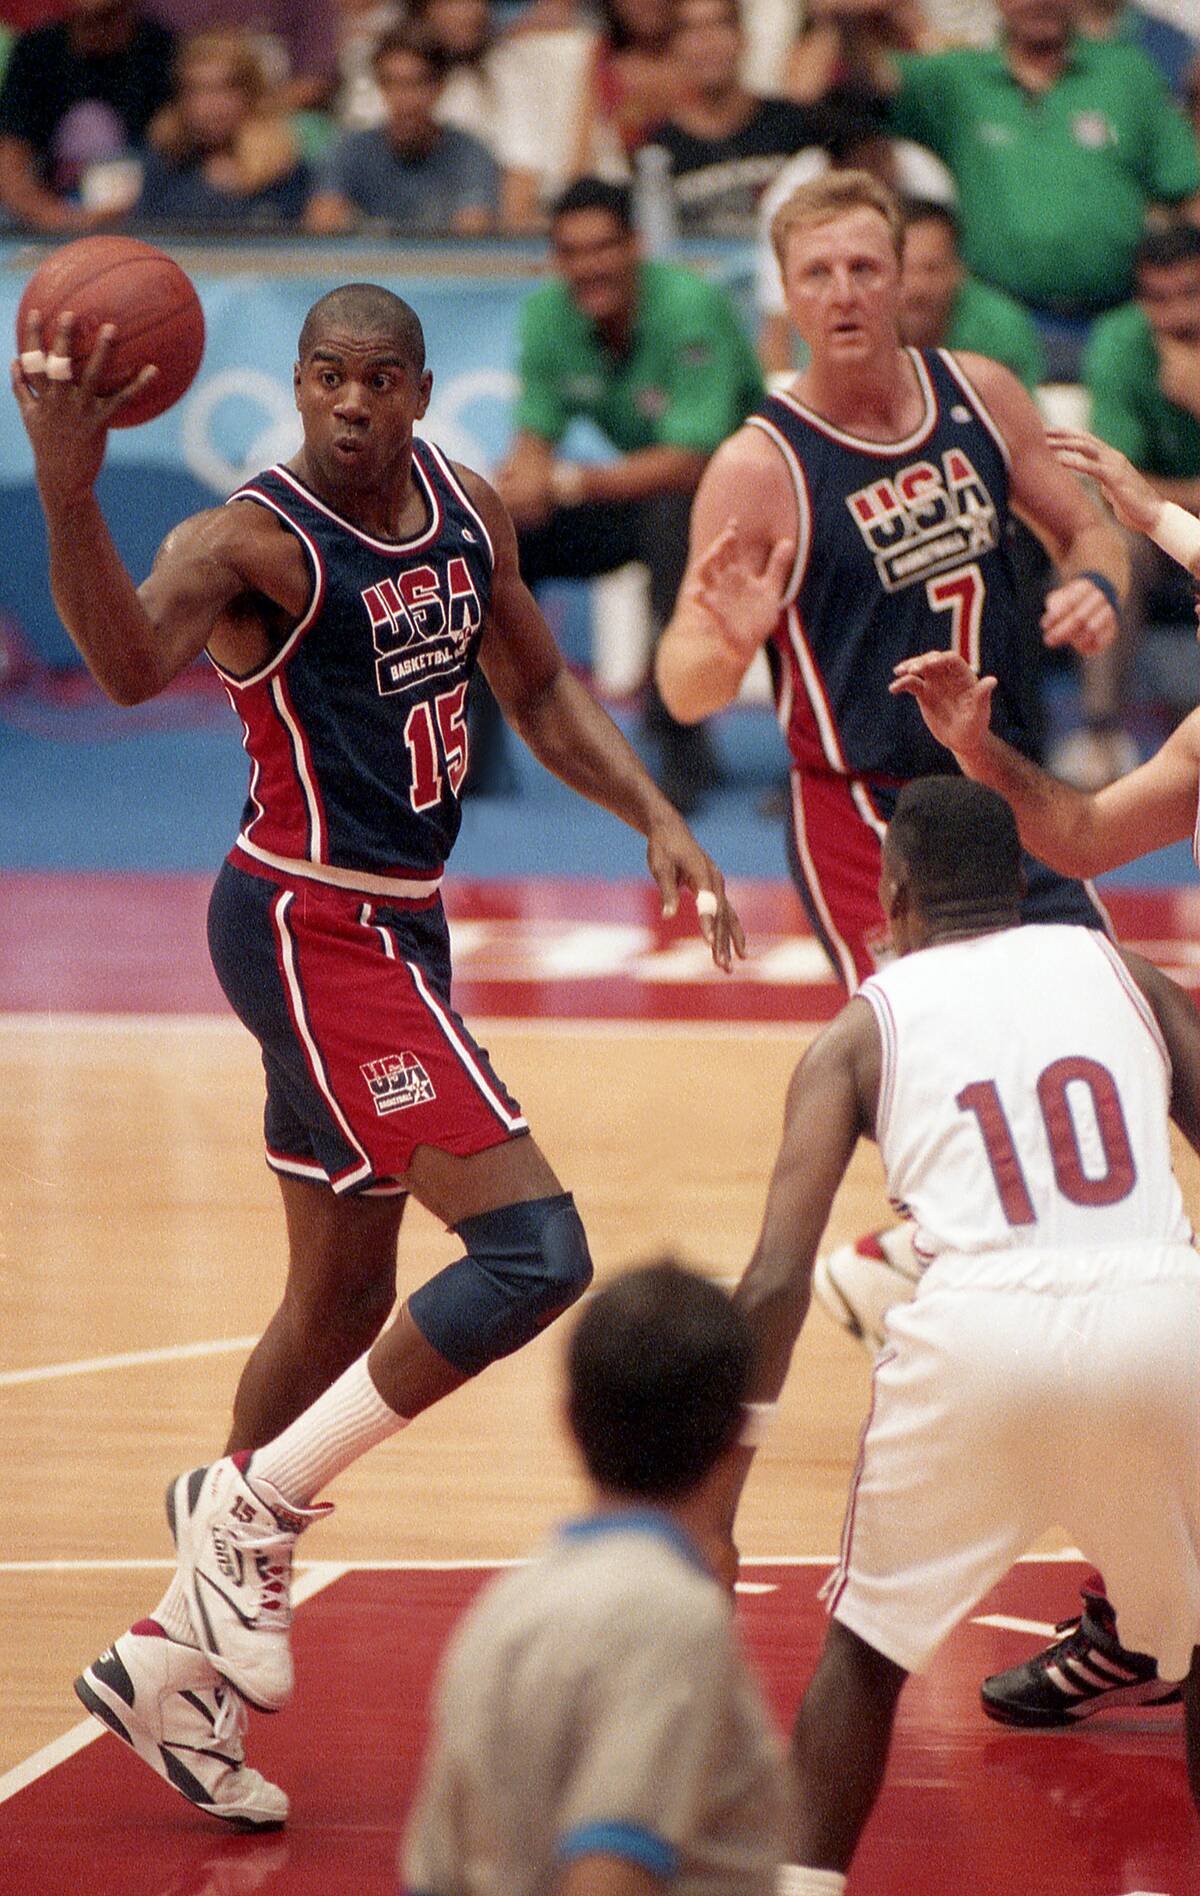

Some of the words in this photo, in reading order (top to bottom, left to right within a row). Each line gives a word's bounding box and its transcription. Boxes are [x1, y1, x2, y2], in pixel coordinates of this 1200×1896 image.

[845, 448, 997, 553] USA
[361, 557, 481, 655] USA
[926, 563, 986, 674] 7
[403, 680, 469, 813] 15
[359, 1050, 432, 1098] USA
[955, 1055, 1137, 1226] 10
[229, 1495, 257, 1523] 15
